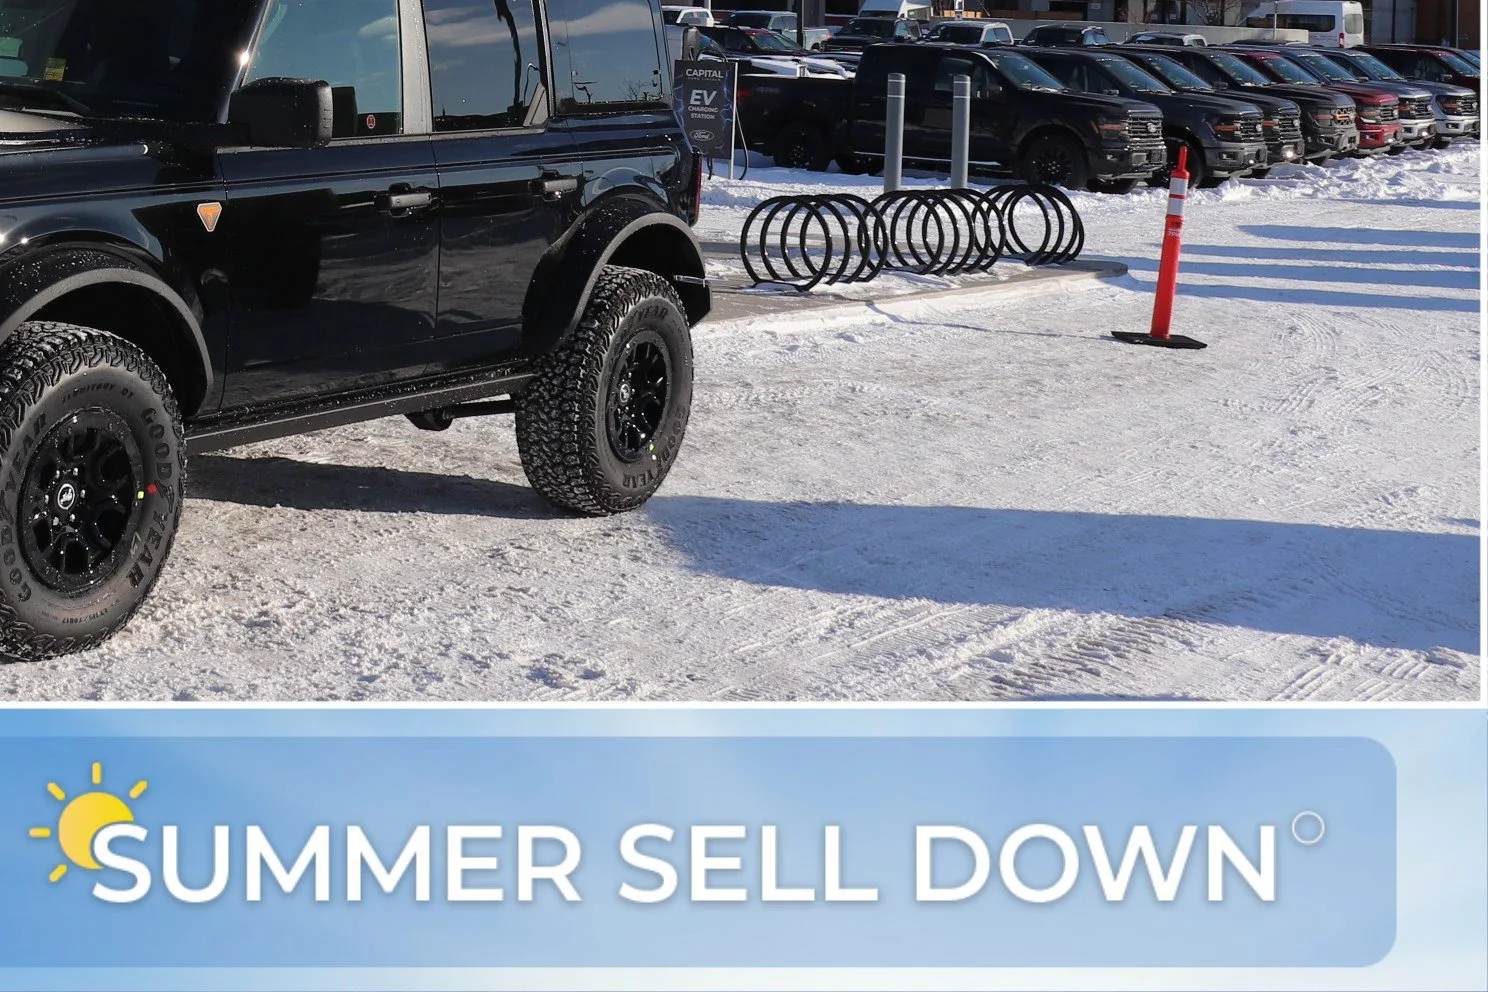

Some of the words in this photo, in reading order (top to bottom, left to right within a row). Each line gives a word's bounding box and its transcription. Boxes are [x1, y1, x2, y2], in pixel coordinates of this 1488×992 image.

[685, 68, 724, 79] CAPITAL
[689, 89, 718, 106] EV
[687, 105, 719, 113] CHARGING
[690, 112, 715, 120] STATION
[126, 408, 175, 588] GOODYEAR
